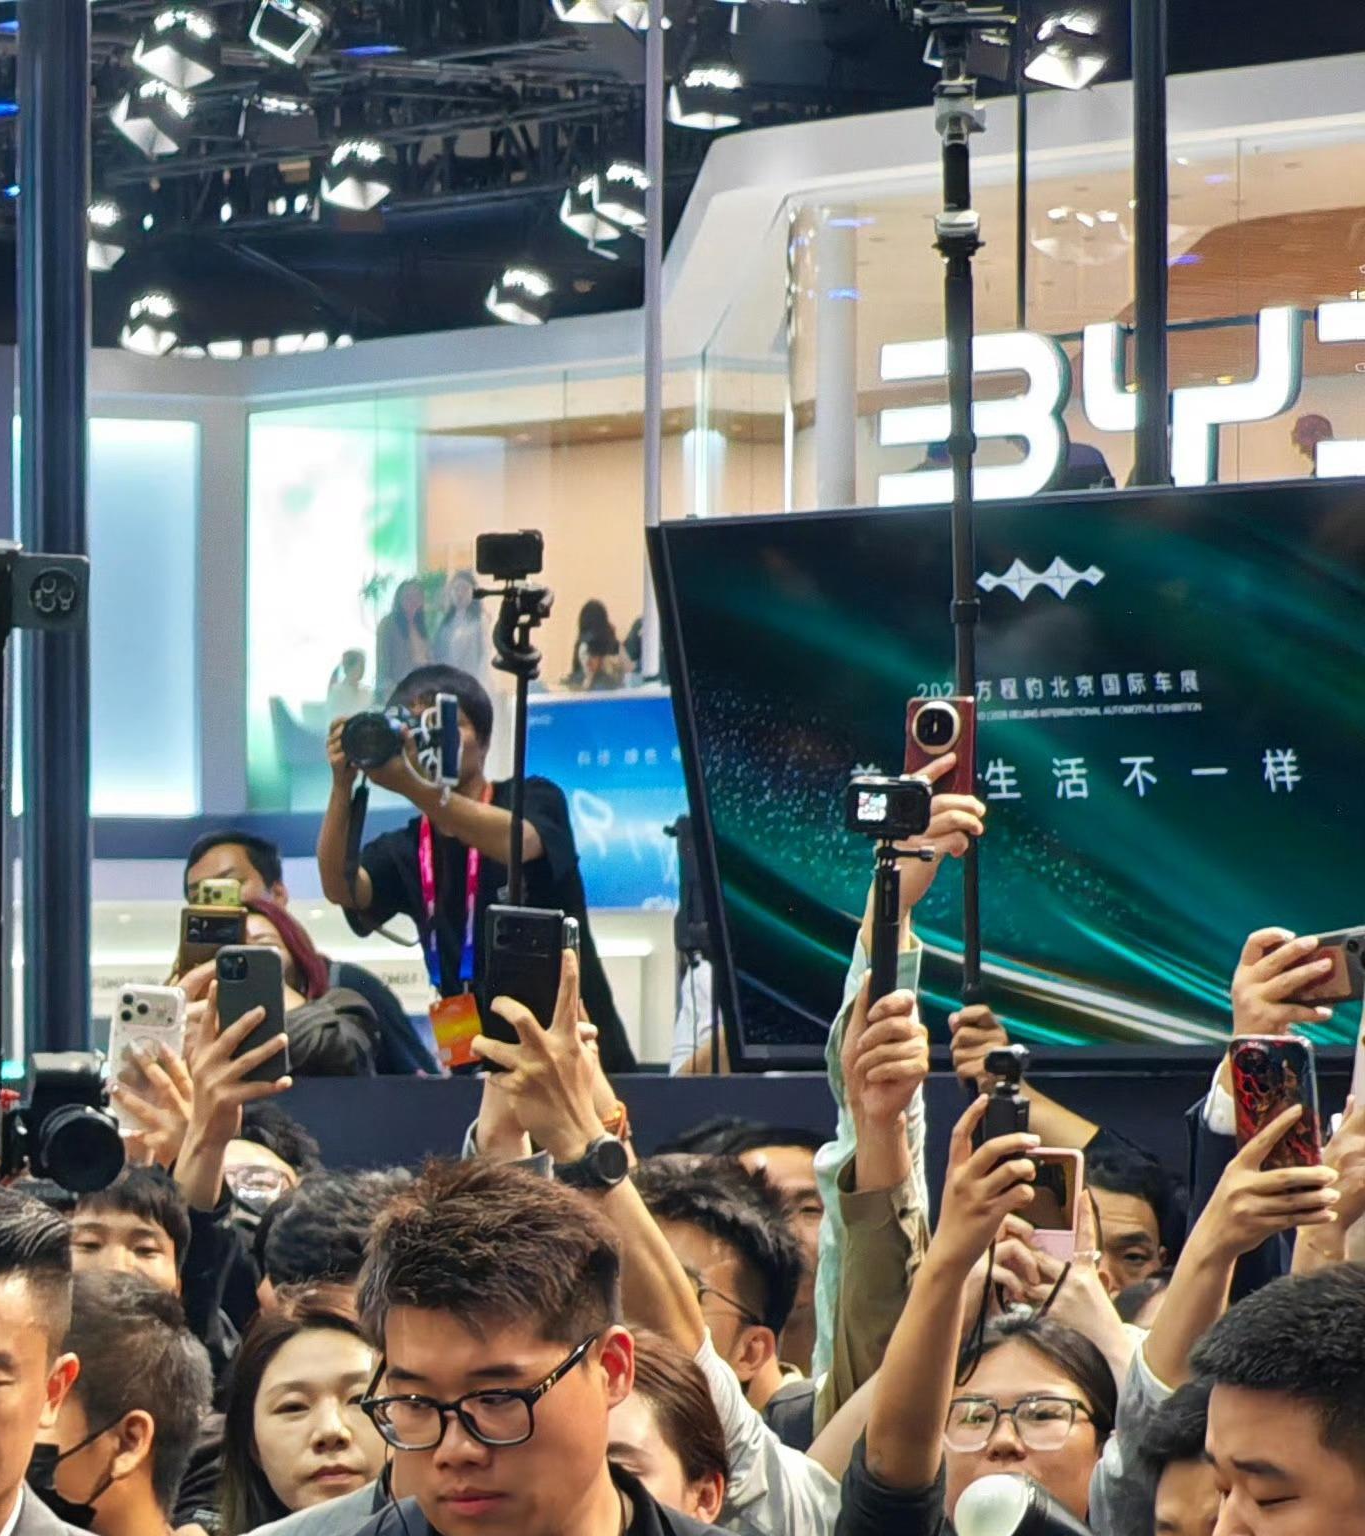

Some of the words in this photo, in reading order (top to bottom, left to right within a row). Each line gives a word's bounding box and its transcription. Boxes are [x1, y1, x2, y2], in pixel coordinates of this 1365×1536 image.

[917, 669, 1200, 702] 202方程豹北京国际车展
